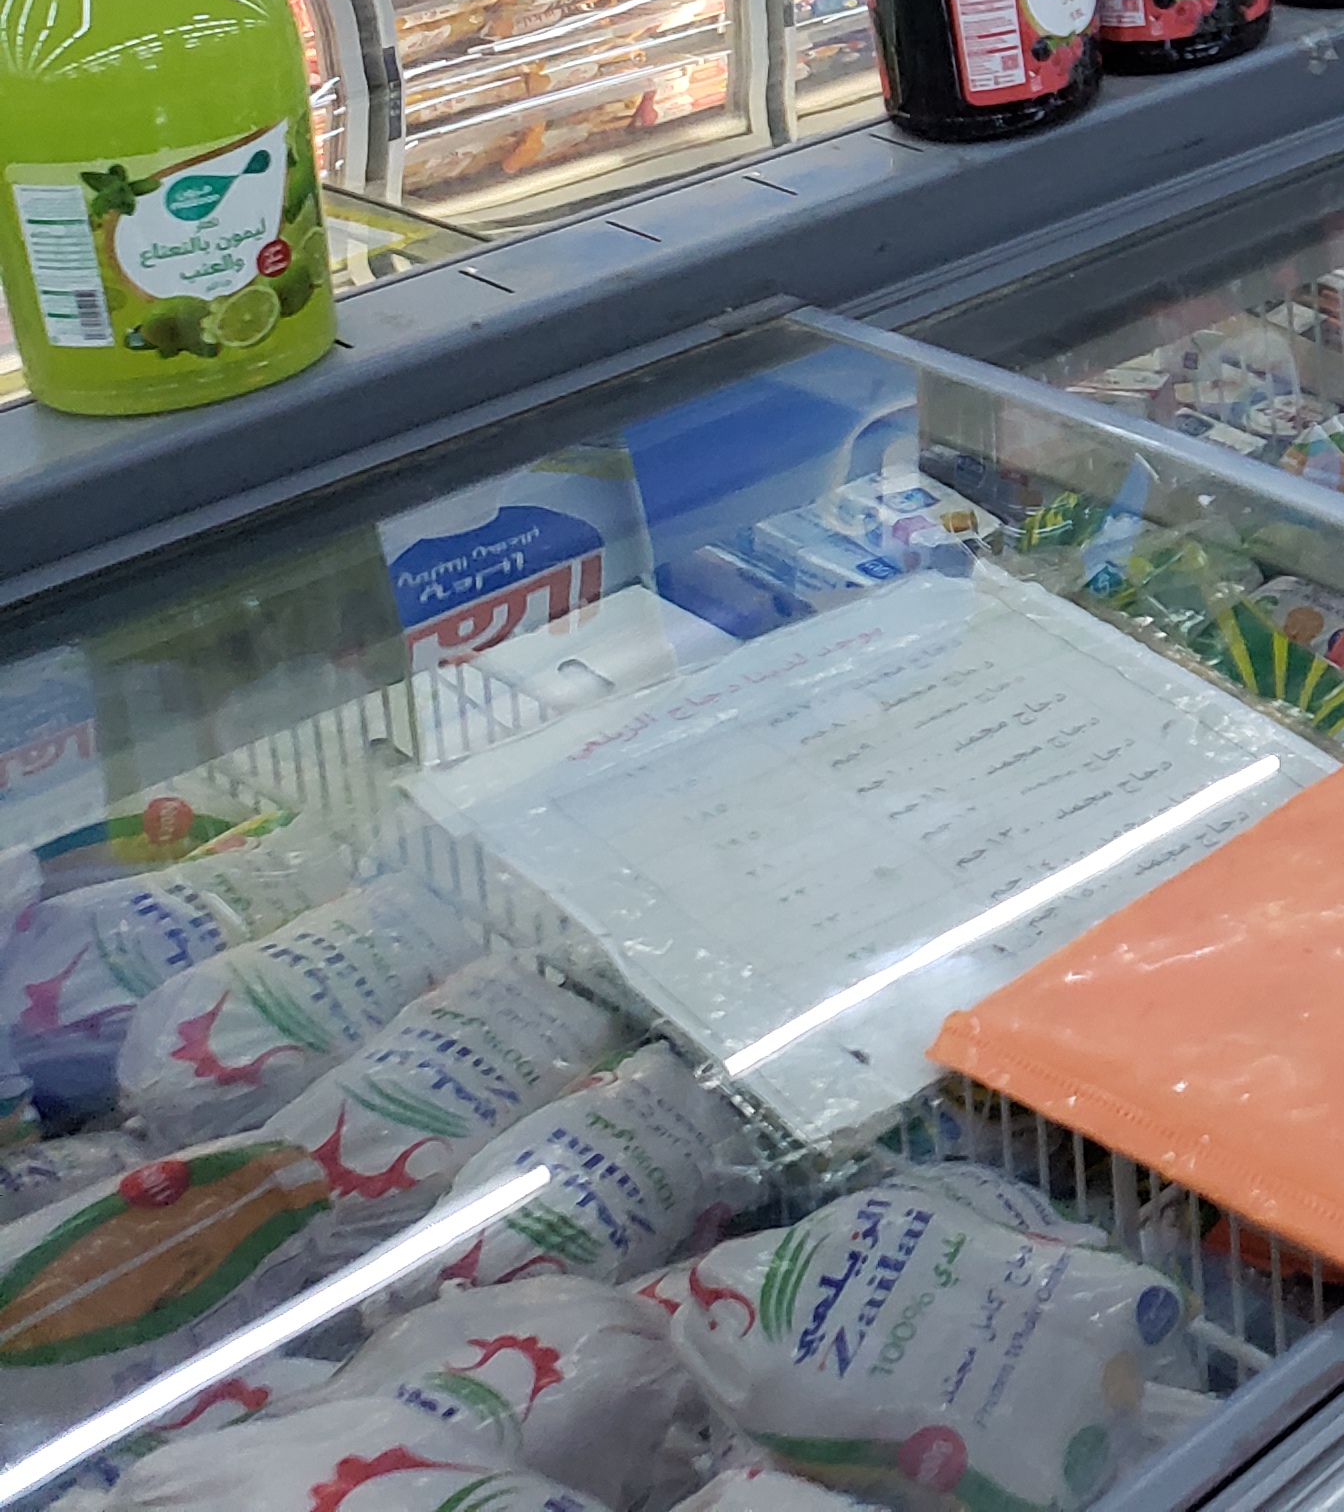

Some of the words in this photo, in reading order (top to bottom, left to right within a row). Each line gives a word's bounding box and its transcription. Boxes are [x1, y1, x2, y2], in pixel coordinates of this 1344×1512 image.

[215, 217, 267, 251] ليمون
[180, 253, 246, 285] والعنب
[667, 683, 742, 721] دجاج
[1012, 692, 1067, 726] دجاج
[954, 720, 1009, 752] مجمد
[1047, 716, 1100, 749] دجاج
[1116, 760, 1173, 795] دجاج
[1056, 790, 1113, 820] مجمد
[1195, 811, 1250, 849] دجاج
[1135, 843, 1192, 877] مجمد
[867, 1291, 936, 1376] 100%
